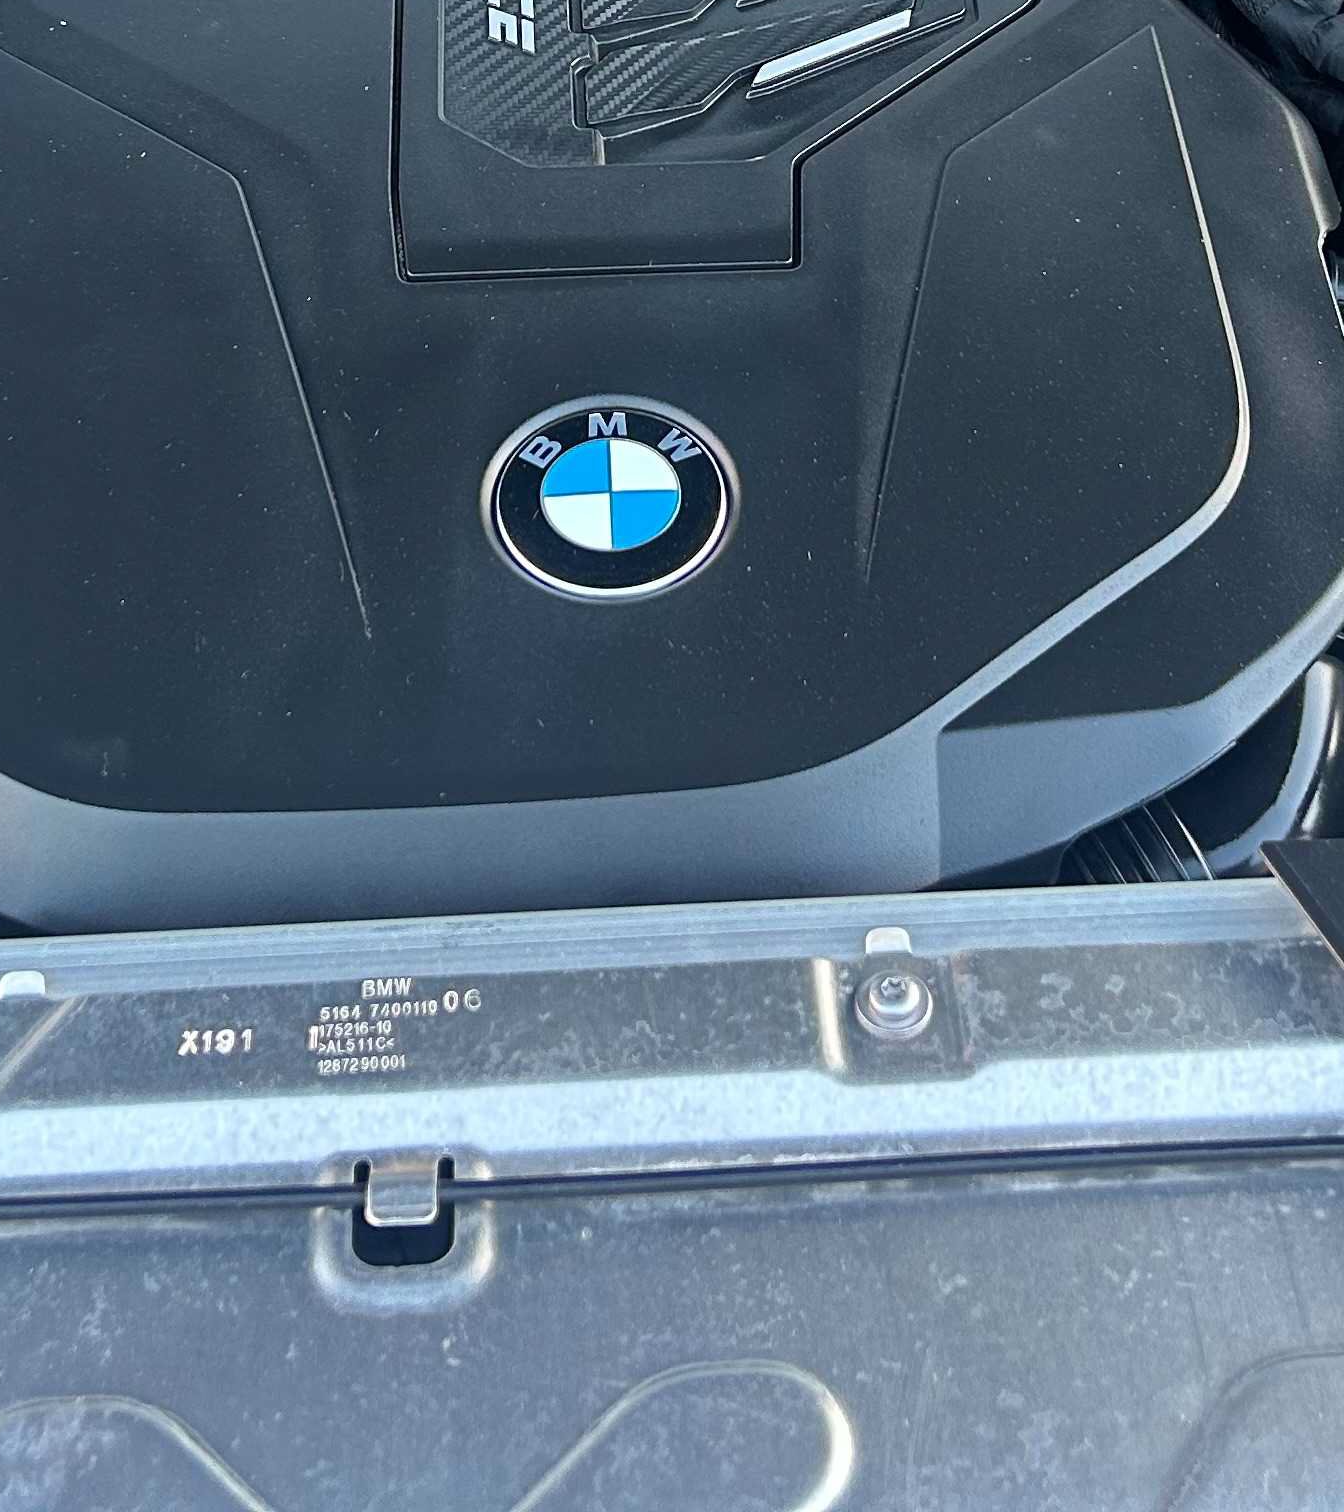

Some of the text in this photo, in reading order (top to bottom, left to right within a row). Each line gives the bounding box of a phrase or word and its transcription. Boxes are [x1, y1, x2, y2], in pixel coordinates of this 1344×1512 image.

[518, 411, 702, 470] BMW
[362, 977, 412, 999] BMW
[320, 1005, 360, 1021] 5164
[177, 1028, 253, 1056] X191
